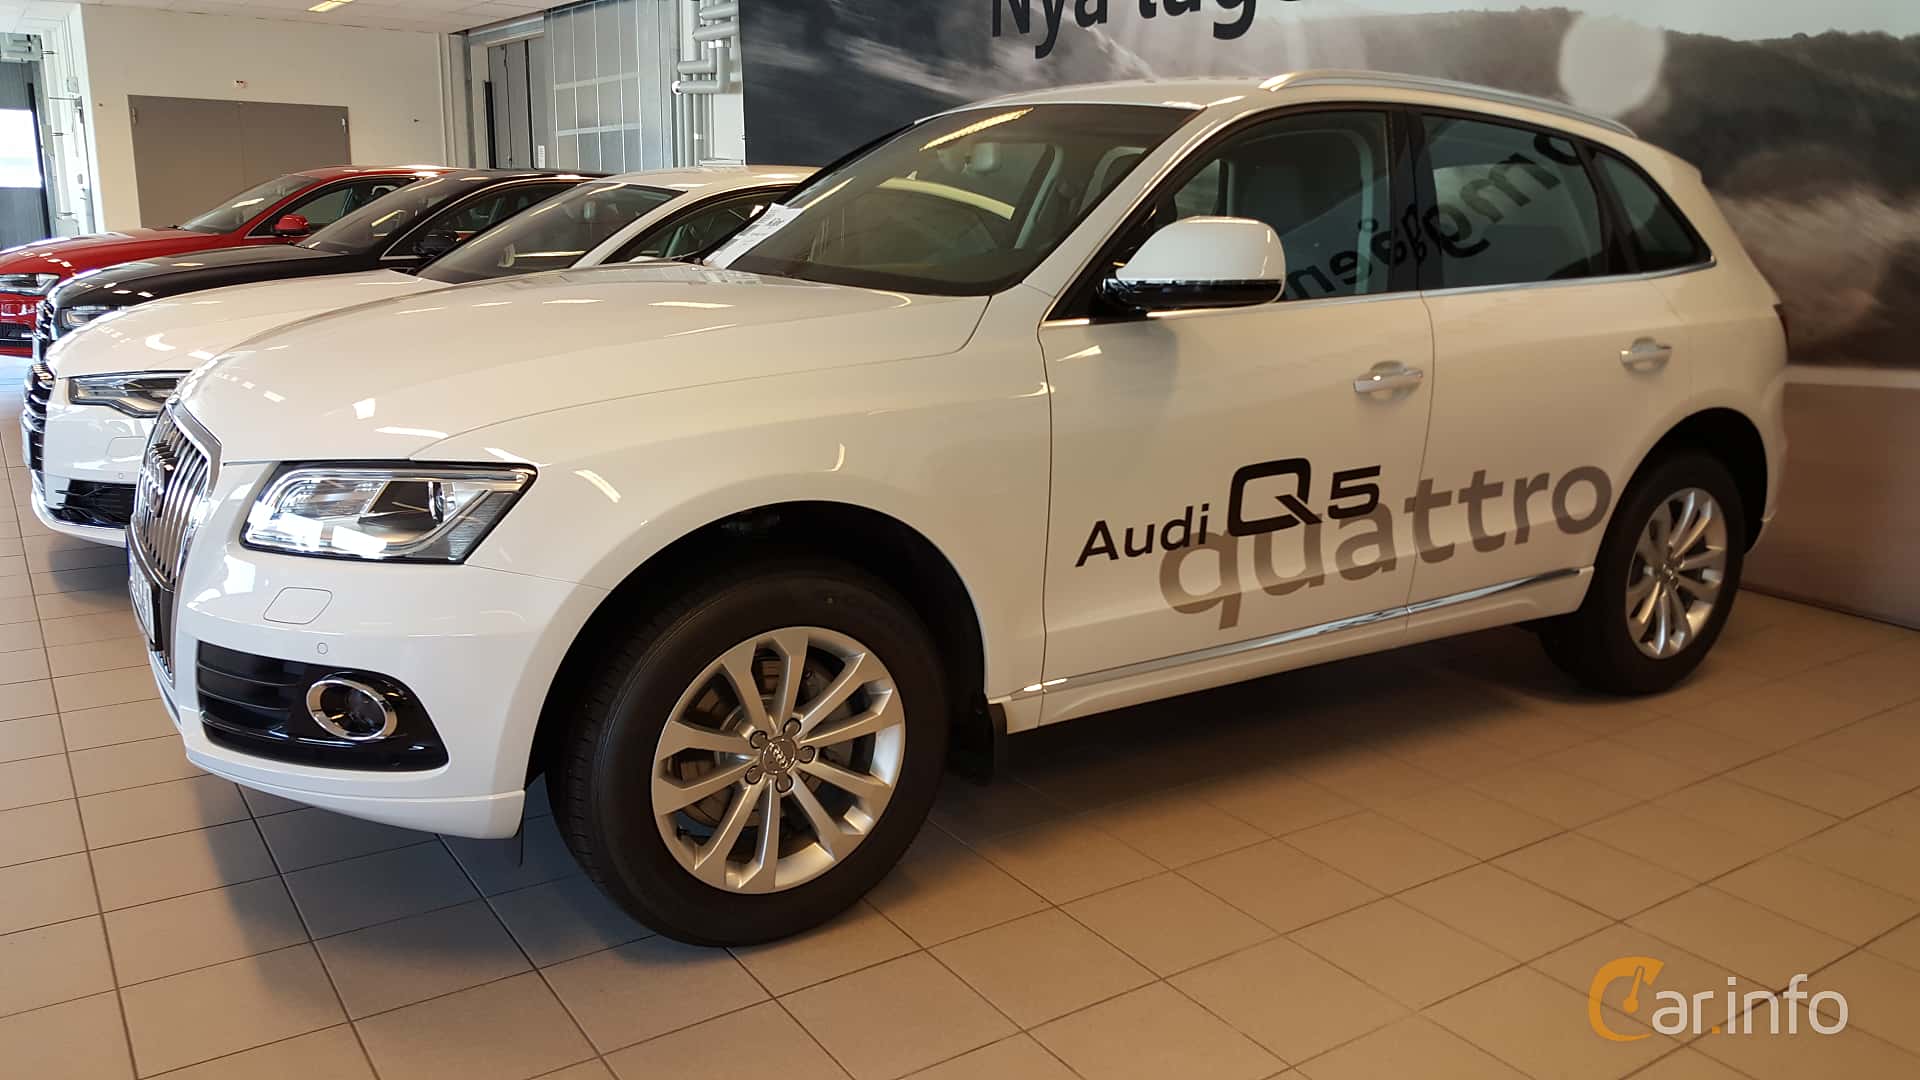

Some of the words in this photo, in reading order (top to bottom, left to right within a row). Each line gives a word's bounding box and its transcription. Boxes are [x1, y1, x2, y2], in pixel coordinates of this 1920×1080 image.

[1075, 503, 1210, 567] Audi
[1227, 457, 1381, 537] Q5
[1159, 465, 1612, 630] quattro
